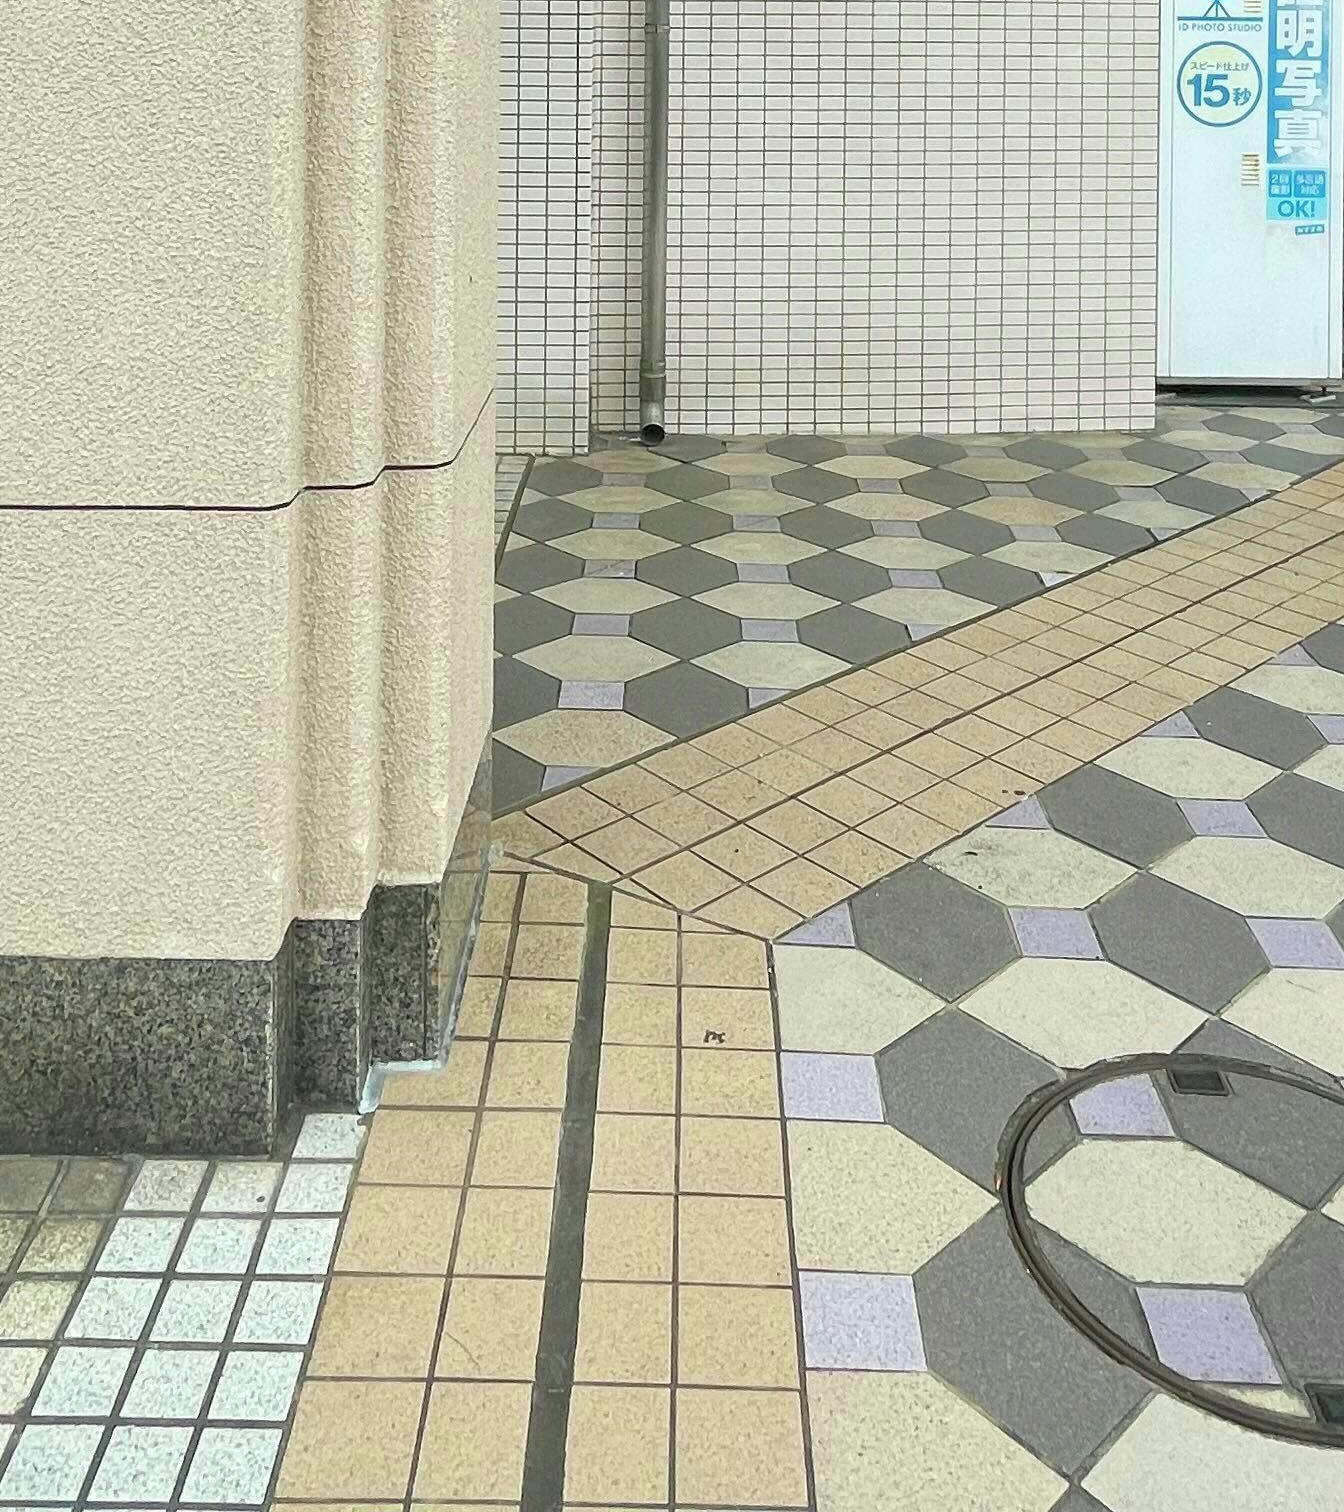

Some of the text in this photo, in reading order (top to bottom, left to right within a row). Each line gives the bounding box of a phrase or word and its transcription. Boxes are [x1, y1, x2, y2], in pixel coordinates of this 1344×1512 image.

[1178, 23, 1262, 32] ID PHOTO STUDIO
[1190, 61, 1249, 71] スピード仕上げ
[1277, 200, 1315, 218] OK!
